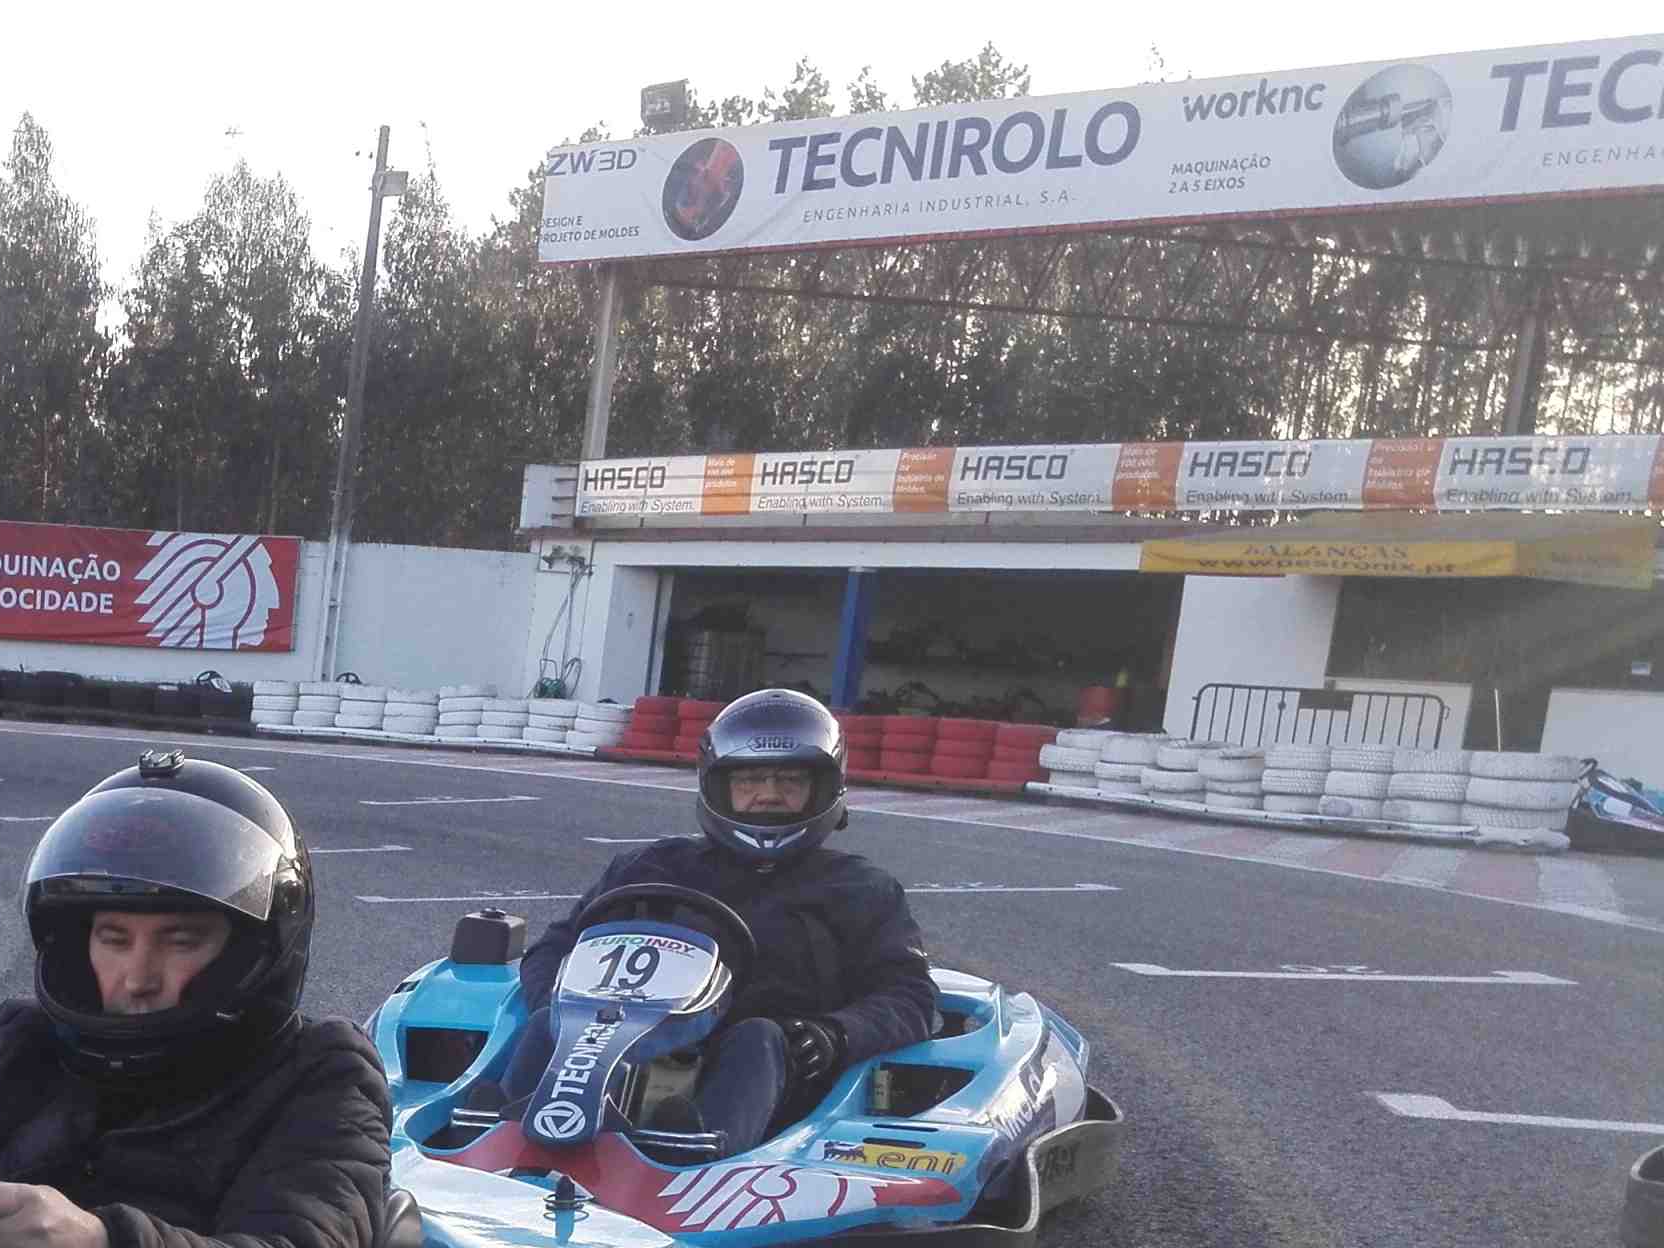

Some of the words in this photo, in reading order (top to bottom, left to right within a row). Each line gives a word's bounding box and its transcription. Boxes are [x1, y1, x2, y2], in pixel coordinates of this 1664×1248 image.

[1182, 78, 1326, 122] worknc
[1490, 48, 1664, 133] TEC
[768, 100, 1141, 194] TECNIROLO
[1541, 143, 1664, 168] ENGENHA
[545, 149, 638, 177] ZW3D
[1170, 152, 1272, 176] MAQUINAÇÃO
[1168, 181, 1177, 194] 2
[1179, 181, 1189, 193] A
[1192, 179, 1201, 192] 5
[1204, 176, 1246, 191] EIXOS
[802, 203, 911, 223] ENGENHARIA
[918, 193, 1030, 213] INDUSTRIAL,
[1039, 189, 1078, 204] S.A.
[575, 215, 584, 226] E
[583, 230, 597, 240] DE
[598, 225, 640, 240] MOLDES
[760, 459, 855, 486] HASCO
[960, 454, 1068, 481] HASCO
[1188, 450, 1312, 477] HASCO
[1448, 447, 1590, 476] HASCO
[584, 465, 667, 491] HASCO
[957, 492, 1013, 507] Enabling
[1017, 491, 1044, 505] with
[1186, 489, 1250, 506] Enabling
[1446, 488, 1519, 505] Enabling
[754, 736, 794, 750] SHOEI
[589, 936, 697, 953] EUROINDY
[598, 944, 661, 989] 19
[877, 1151, 957, 1175] eni
